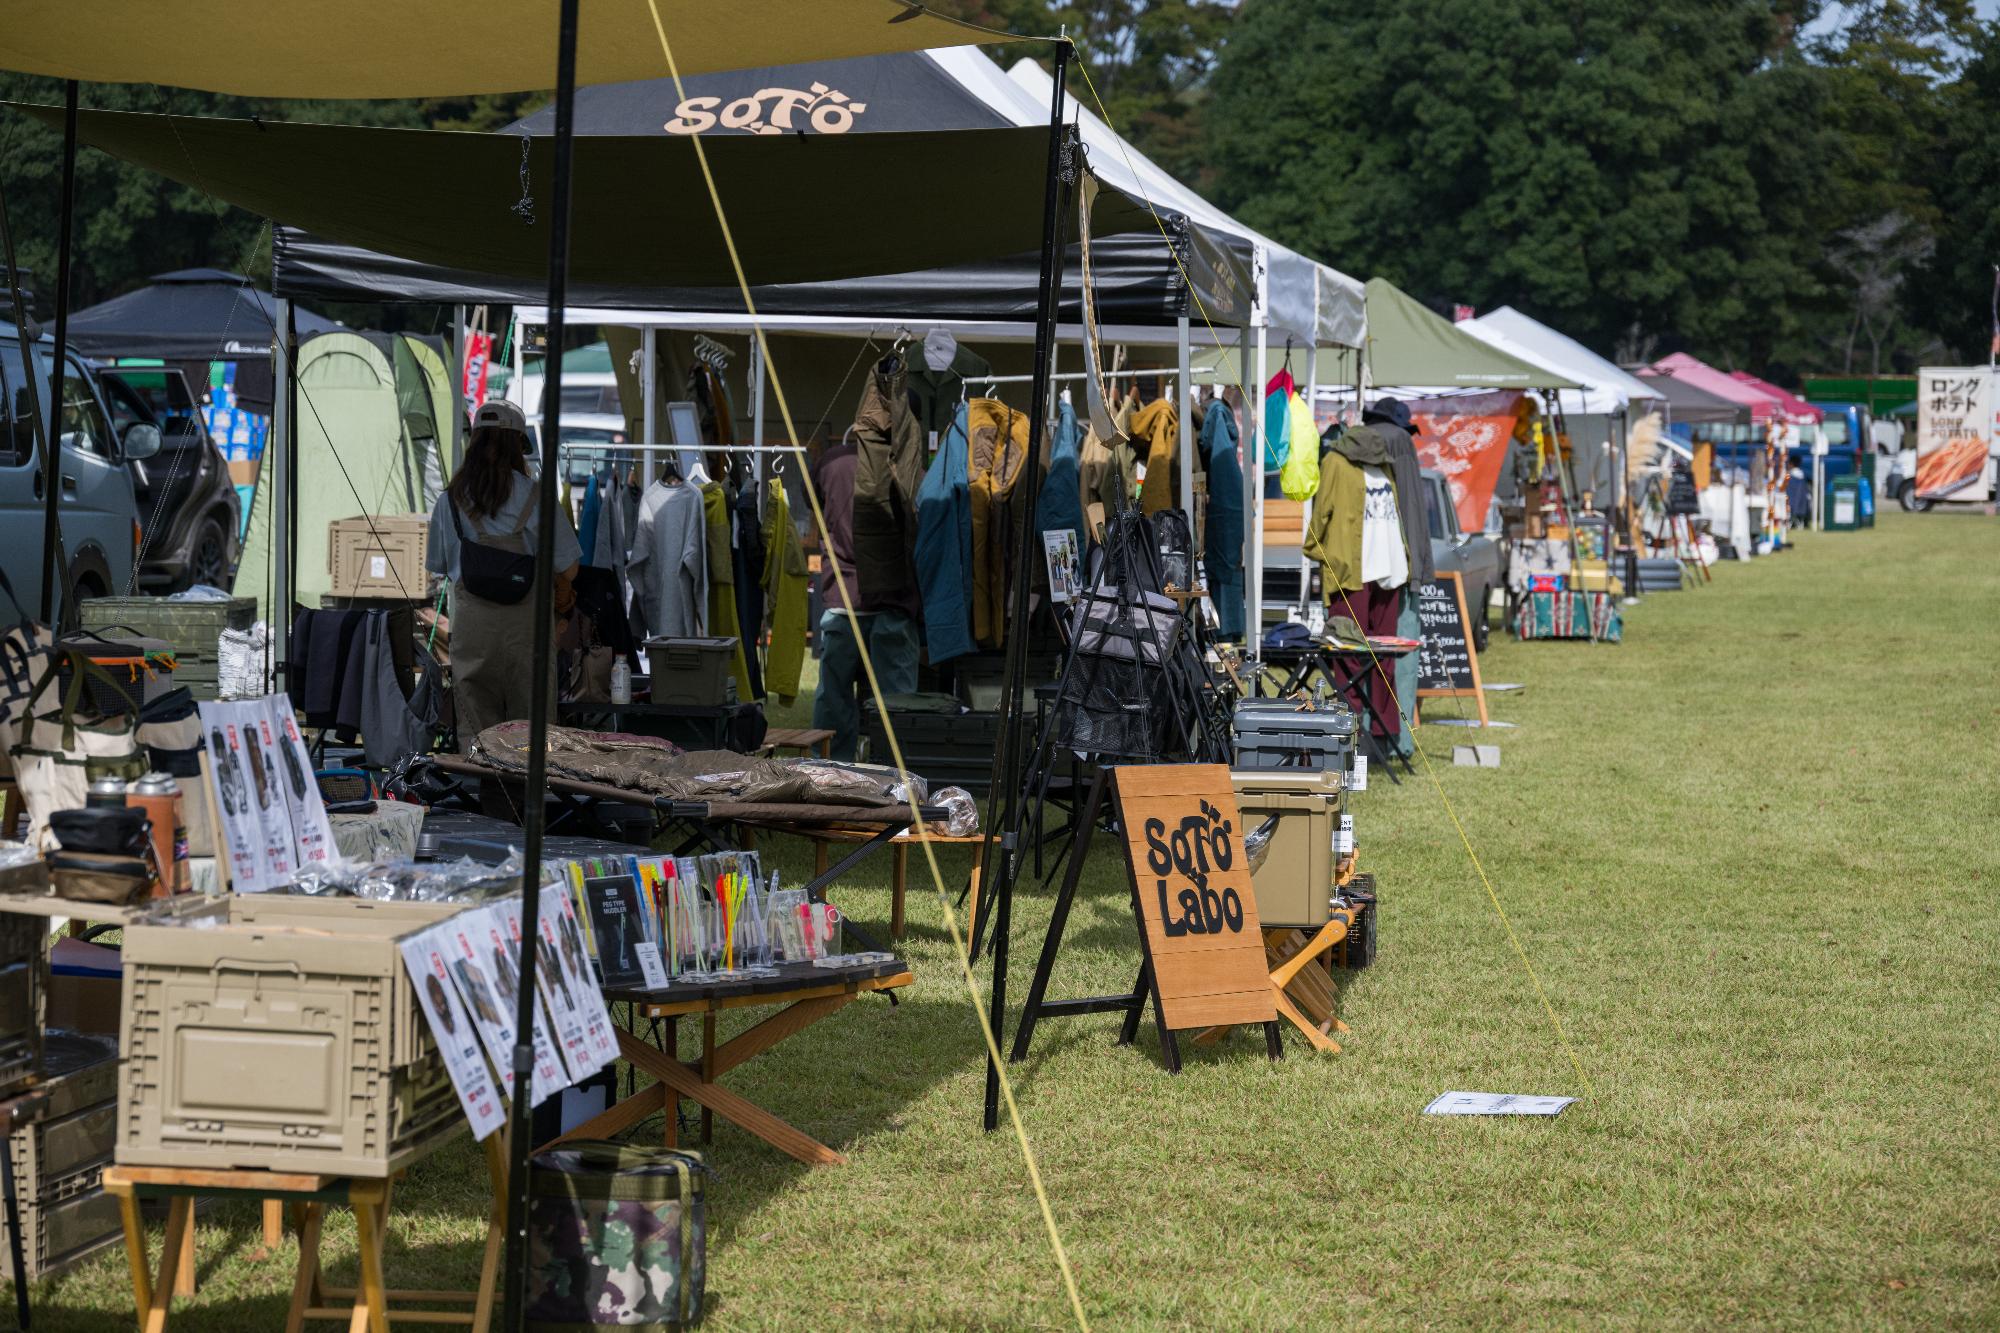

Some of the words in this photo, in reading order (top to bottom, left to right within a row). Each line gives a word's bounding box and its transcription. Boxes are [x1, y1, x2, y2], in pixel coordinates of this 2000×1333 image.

[1931, 378, 1981, 396] ロング
[1930, 395, 1977, 413] ポテト
[1157, 873, 1244, 937] Labo
